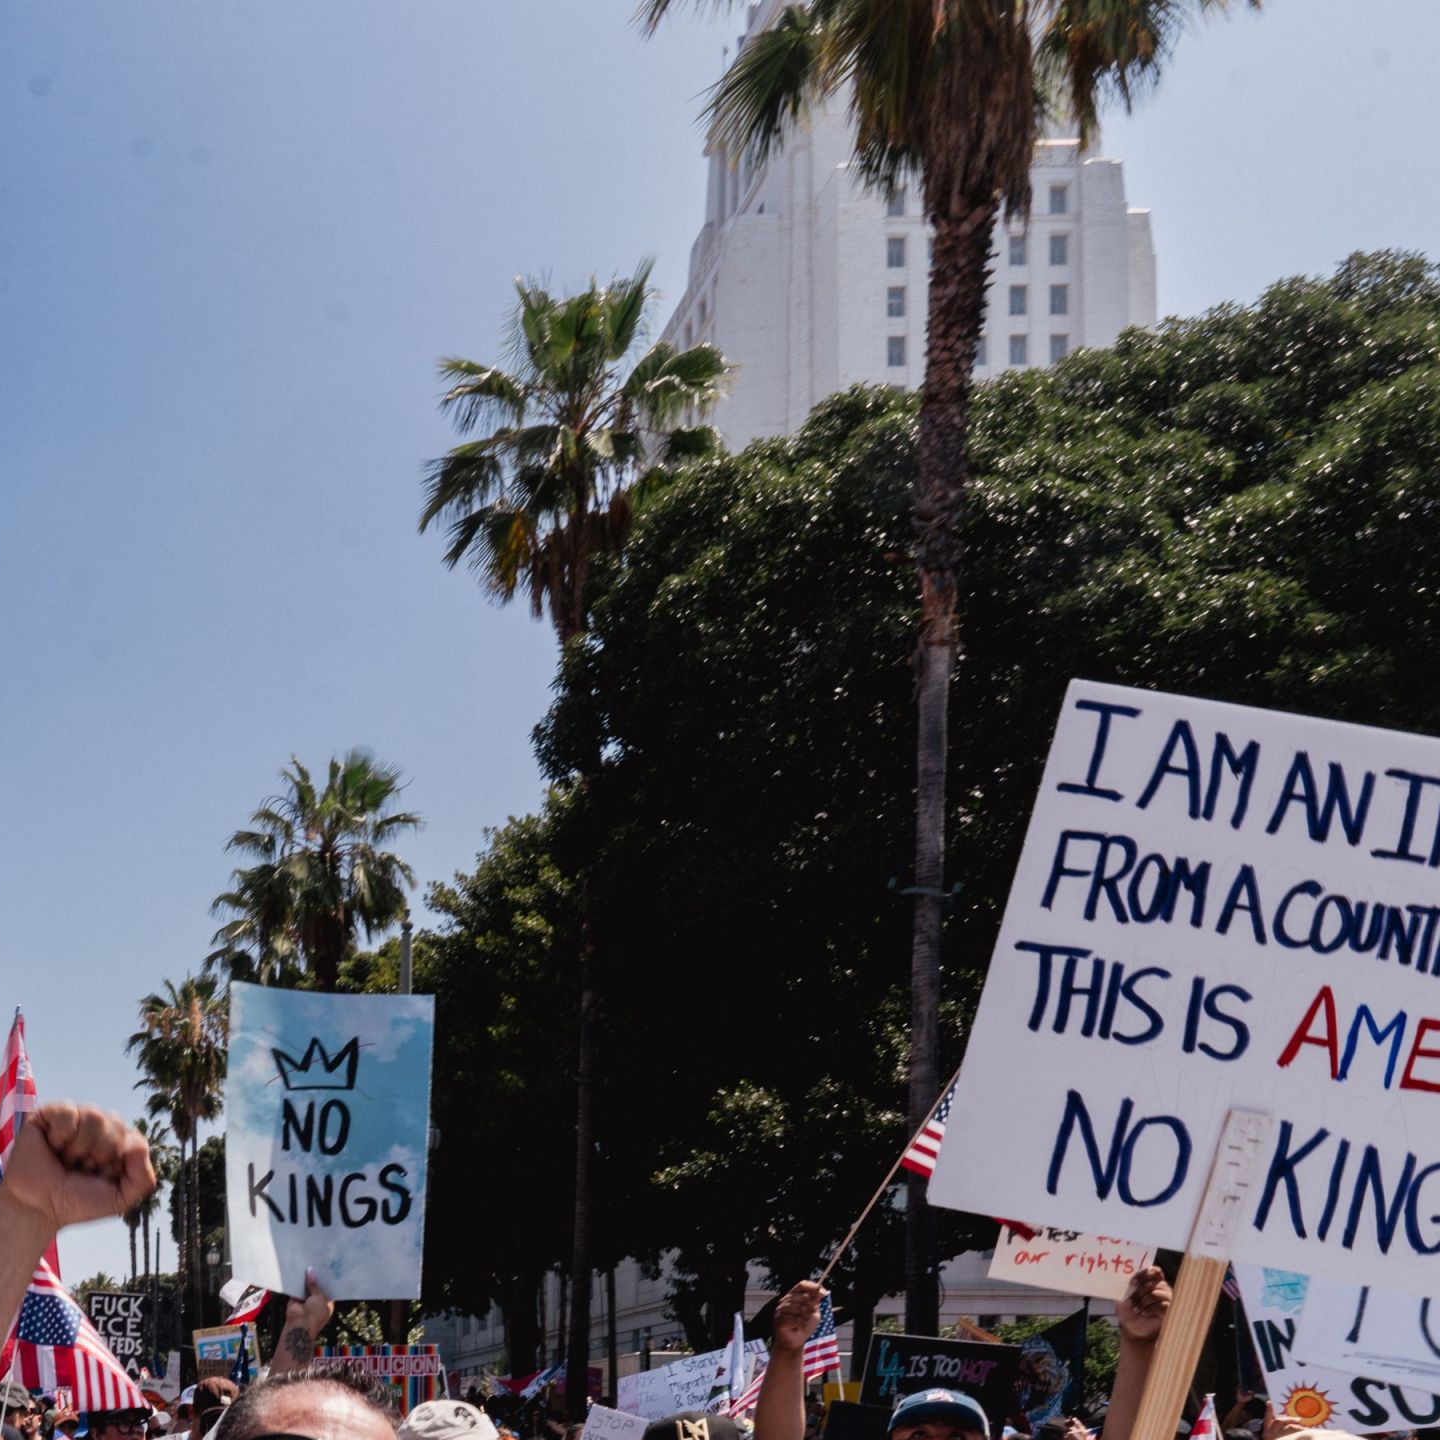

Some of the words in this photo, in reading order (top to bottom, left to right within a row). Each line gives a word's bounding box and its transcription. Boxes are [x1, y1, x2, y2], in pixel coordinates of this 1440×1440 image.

[1056, 699, 1142, 801] I
[1135, 719, 1261, 829] AM
[1265, 751, 1376, 846] AN
[1040, 829, 1212, 931] FROM
[1215, 864, 1268, 946] A
[1272, 879, 1440, 976] COUNT
[1014, 940, 1173, 1046] THIS
[1182, 975, 1254, 1061] IS
[281, 1098, 351, 1156] NO
[1046, 1088, 1192, 1208] NO
[248, 1162, 414, 1229] KINGS
[90, 1295, 144, 1319] FUCK
[94, 1315, 142, 1337] ICE
[315, 1355, 439, 1376] OLUCION
[905, 1355, 929, 1378] IS
[932, 1354, 960, 1378] TOO
[959, 1359, 999, 1388] HOT
[590, 1411, 635, 1432] STOP
